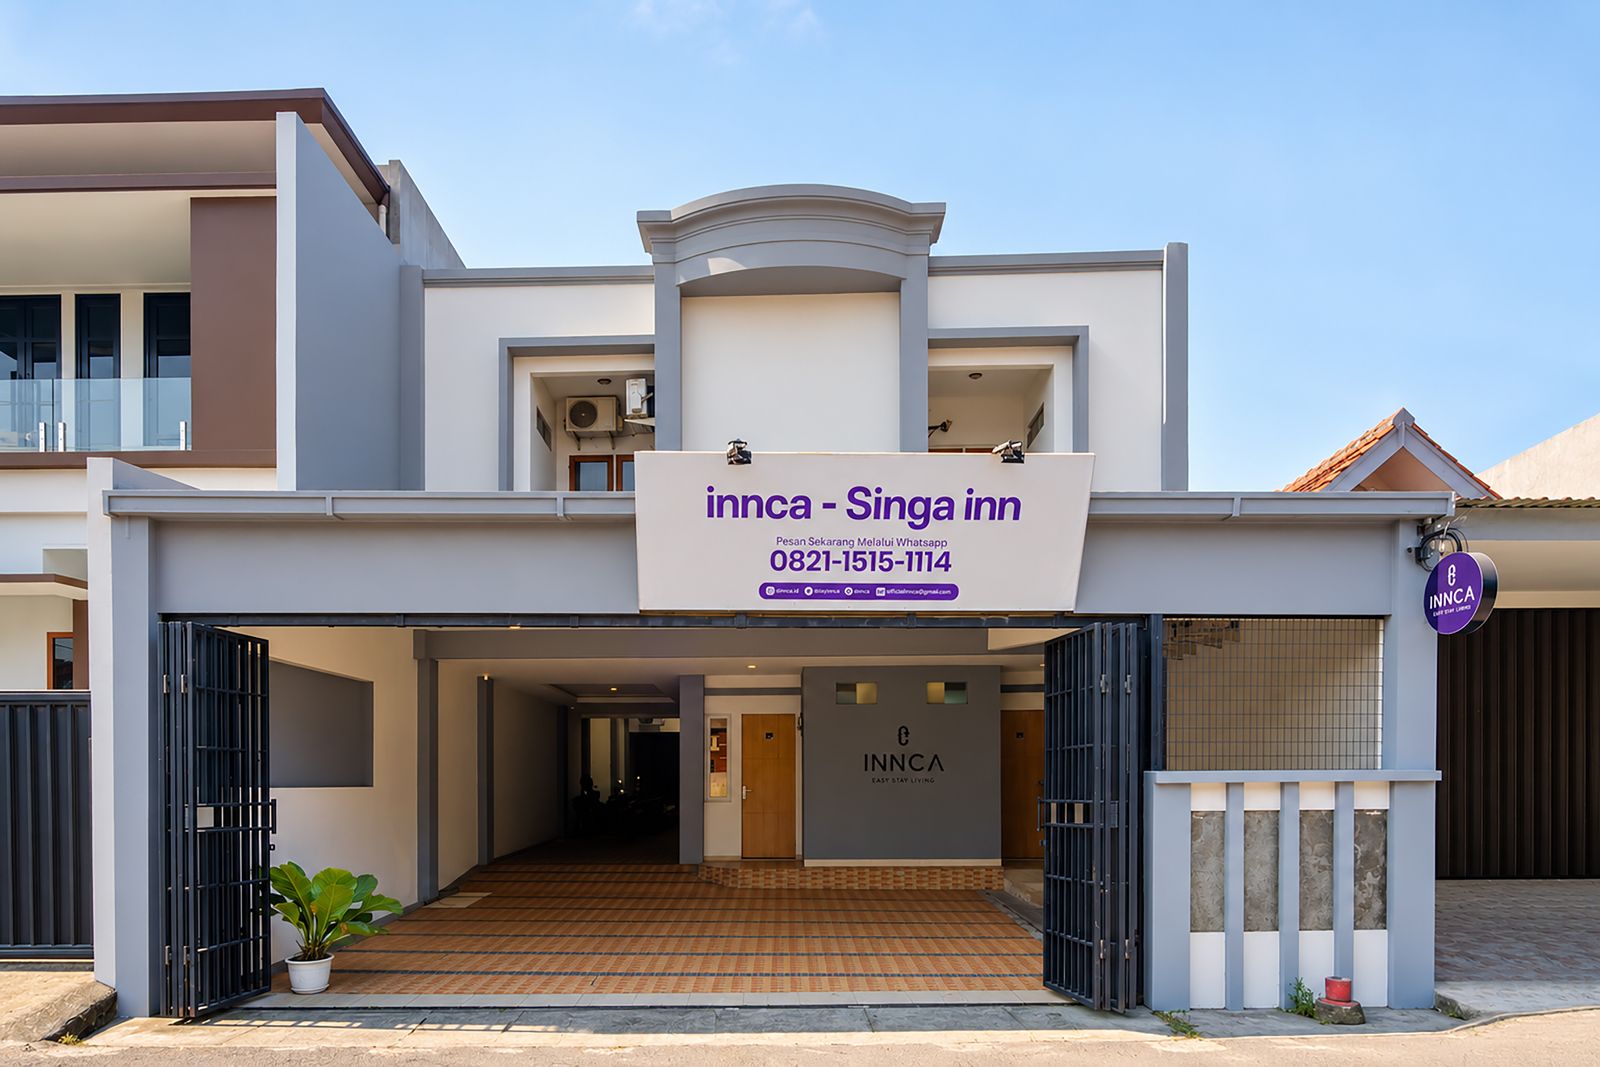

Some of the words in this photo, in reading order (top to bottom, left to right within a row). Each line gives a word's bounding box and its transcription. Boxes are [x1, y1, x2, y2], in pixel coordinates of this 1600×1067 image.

[707, 485, 812, 520] innca
[846, 485, 955, 530] Singa
[964, 487, 1022, 521] inn
[776, 536, 806, 546] Pesan
[808, 537, 854, 549] Sekarang
[857, 538, 894, 547] Melalui
[896, 538, 948, 549] Whatsapp
[770, 550, 952, 572] 0821-1515-1114
[1429, 585, 1475, 609] INNCA
[864, 753, 945, 772] INNCA
